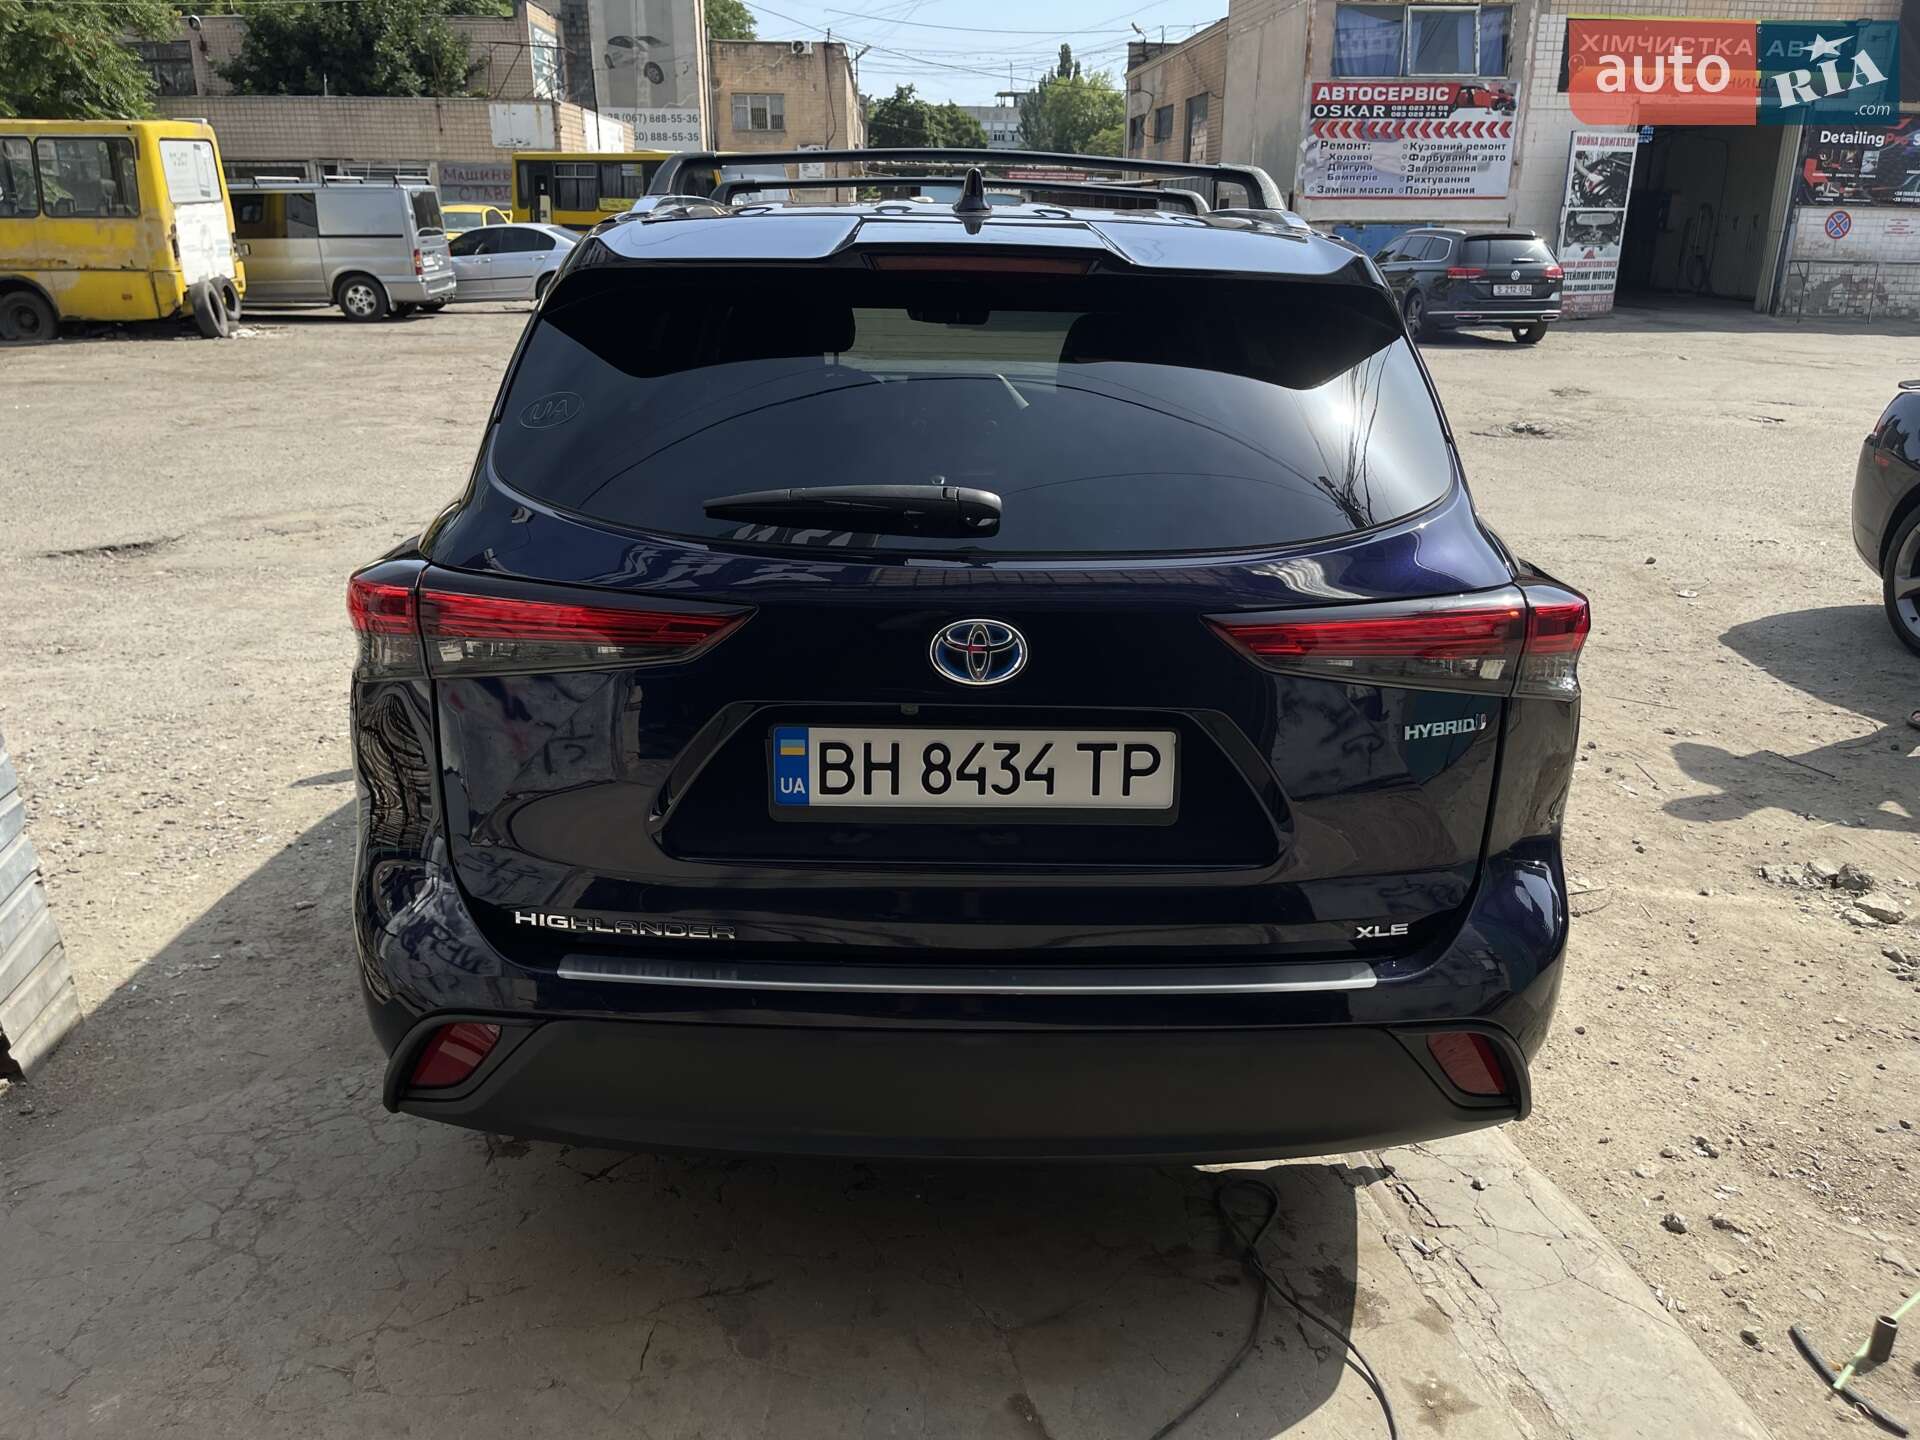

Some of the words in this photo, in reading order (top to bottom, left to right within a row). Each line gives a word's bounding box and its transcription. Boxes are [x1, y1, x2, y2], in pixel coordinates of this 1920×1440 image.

[1316, 86, 1450, 101] АВТОСЕРВІС
[1314, 104, 1385, 117] OSKAR
[1320, 141, 1371, 150] Ремонт:
[1410, 142, 1462, 152] Кузовний
[1466, 144, 1506, 153] ремонт
[1408, 153, 1478, 163] Фарбування
[1327, 163, 1373, 173] Двигуна
[1407, 164, 1476, 174] Зварювання
[1327, 173, 1378, 183] Бамперів
[1406, 175, 1470, 185] Рихтування
[1317, 185, 1355, 194] Заміна
[1405, 185, 1475, 196] Полірування
[1404, 718, 1477, 741] HYBRID
[818, 741, 901, 796] BH
[920, 742, 1056, 796] 8434
[1076, 742, 1162, 797] TP
[780, 777, 806, 794] UA
[514, 911, 736, 939] HIGHLANDER
[1356, 923, 1409, 939] XLE
